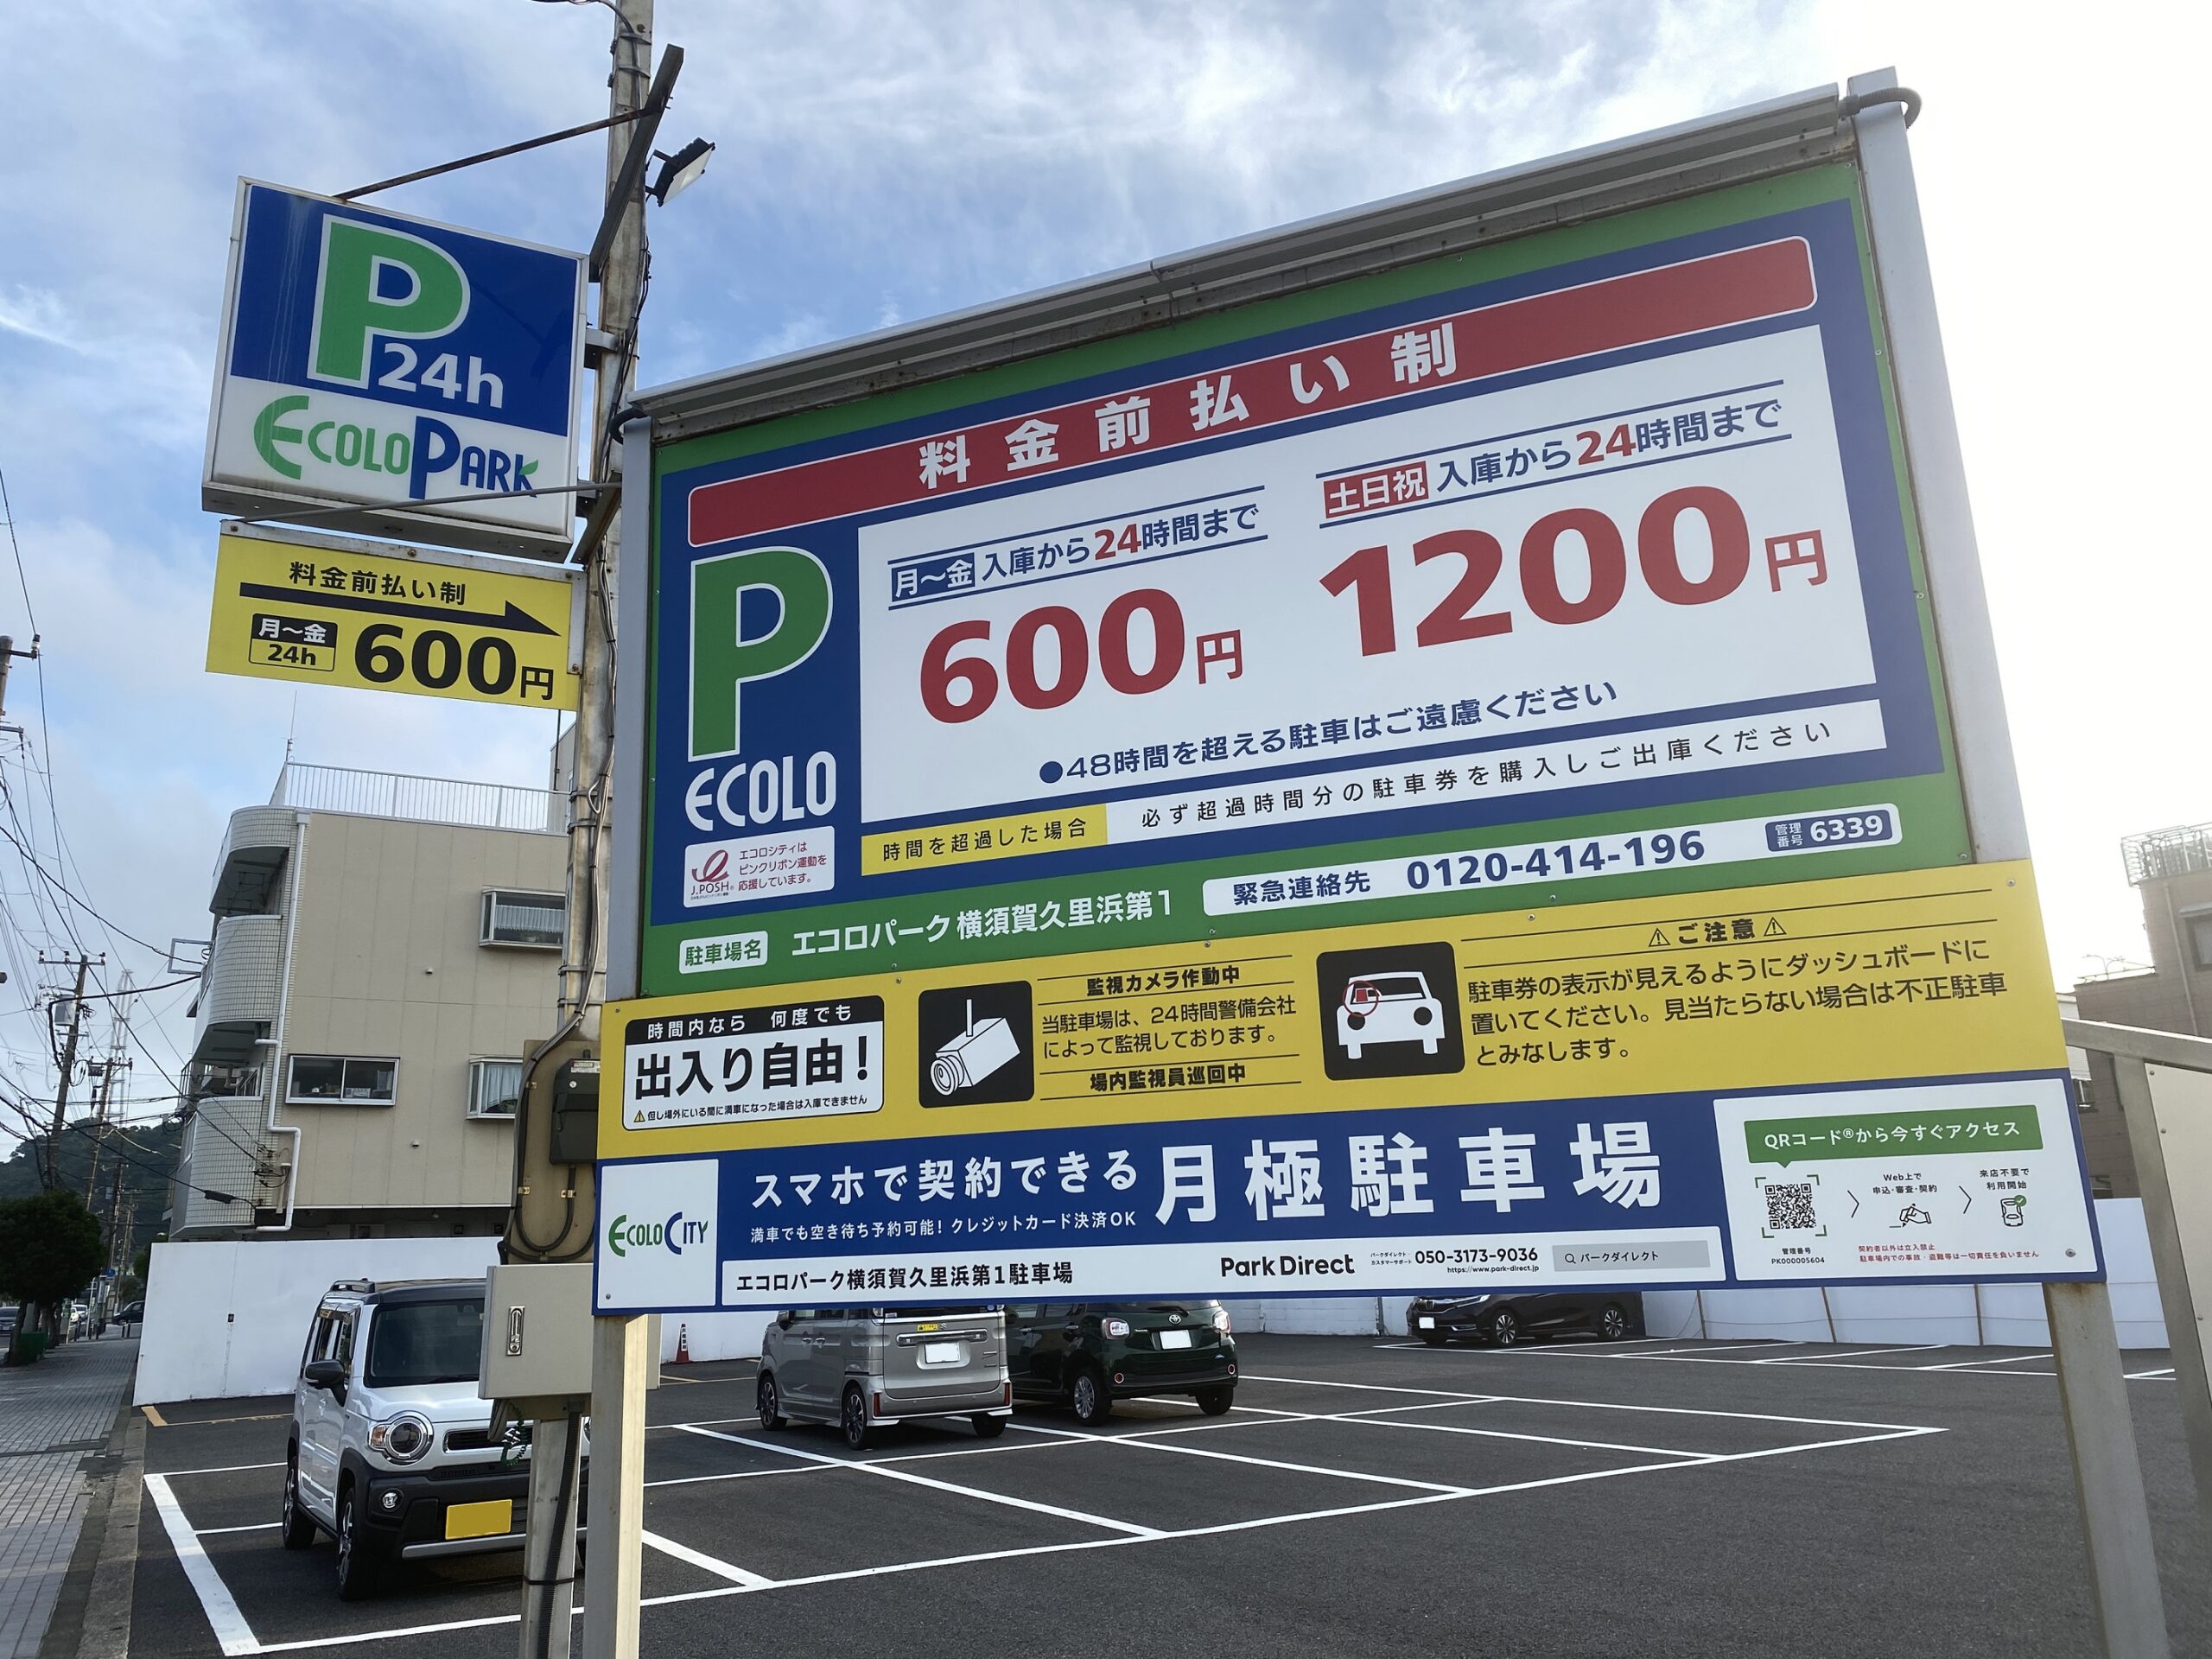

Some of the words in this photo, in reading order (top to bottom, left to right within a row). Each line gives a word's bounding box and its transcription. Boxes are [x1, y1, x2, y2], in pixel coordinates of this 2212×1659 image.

[307, 213, 470, 390] P
[378, 343, 504, 410] 24h
[918, 323, 1456, 490] 料金前払い制
[1328, 467, 1427, 516] 土日祝
[1437, 397, 1783, 492] 入庫から24時間まで
[982, 504, 1260, 582] 入庫から24時間まで
[289, 562, 466, 606] 料金前払い制
[1319, 486, 1829, 658] 1200円
[267, 644, 317, 667] 24h
[354, 623, 554, 701] 600円
[688, 545, 833, 762] P
[919, 588, 1243, 723] 600円
[1141, 721, 1831, 828] 必ず超過時間分の駐車券を購入しご出庫ください
[685, 750, 836, 831] ECOLO
[882, 817, 1087, 861] 時間を超過した場合
[1775, 822, 1802, 835] 管理
[1777, 834, 1803, 848] 番号
[1810, 815, 1884, 842] 6339
[740, 842, 807, 860] エコロシティは
[740, 855, 827, 875] ピンクリボン運動を
[739, 873, 810, 892] 応援しています。
[1233, 869, 1371, 906] 緊急連絡先
[1407, 830, 1706, 890] 0120-414-196
[1677, 917, 1756, 945] ご注意
[684, 938, 762, 967] 駐車場名
[1086, 964, 1241, 997] 監視カメラ作動中
[1467, 938, 1990, 1004] 駐車券の表示が見えるようにダッシュボードに
[648, 1014, 746, 1040] 時間内なら
[771, 1004, 852, 1028] 何度でも
[1041, 994, 1297, 1035] 当駐車場は、24時間警備会社
[1044, 1025, 1276, 1058] によって監視しております。
[1475, 1035, 1629, 1067] とみなします。
[1090, 1064, 1246, 1093] 場内監視員巡回中
[752, 1149, 1138, 1209] スマホで契約できる
[1155, 1121, 1661, 1226] 月極駐車場
[1883, 1172, 1922, 1183] Web上で
[1979, 1167, 2030, 1179] 来店不要で
[1986, 1180, 2028, 1191] 利用開始
[1414, 1247, 1538, 1265] 050-3173-9036
[1580, 1250, 1660, 1263] パークダイレクト
[1771, 1256, 1825, 1265] PK000005604
[1782, 1247, 1812, 1255] 管理番号
[1858, 1243, 1936, 1252] 契約者以外は立入禁止
[735, 1261, 1074, 1292] エコロパーク横須賀久里浜第1駐車場
[1220, 1255, 1275, 1278] Park
[1280, 1253, 1355, 1276] Direct
[1447, 1265, 1540, 1274] https://www.park-direct.jp
